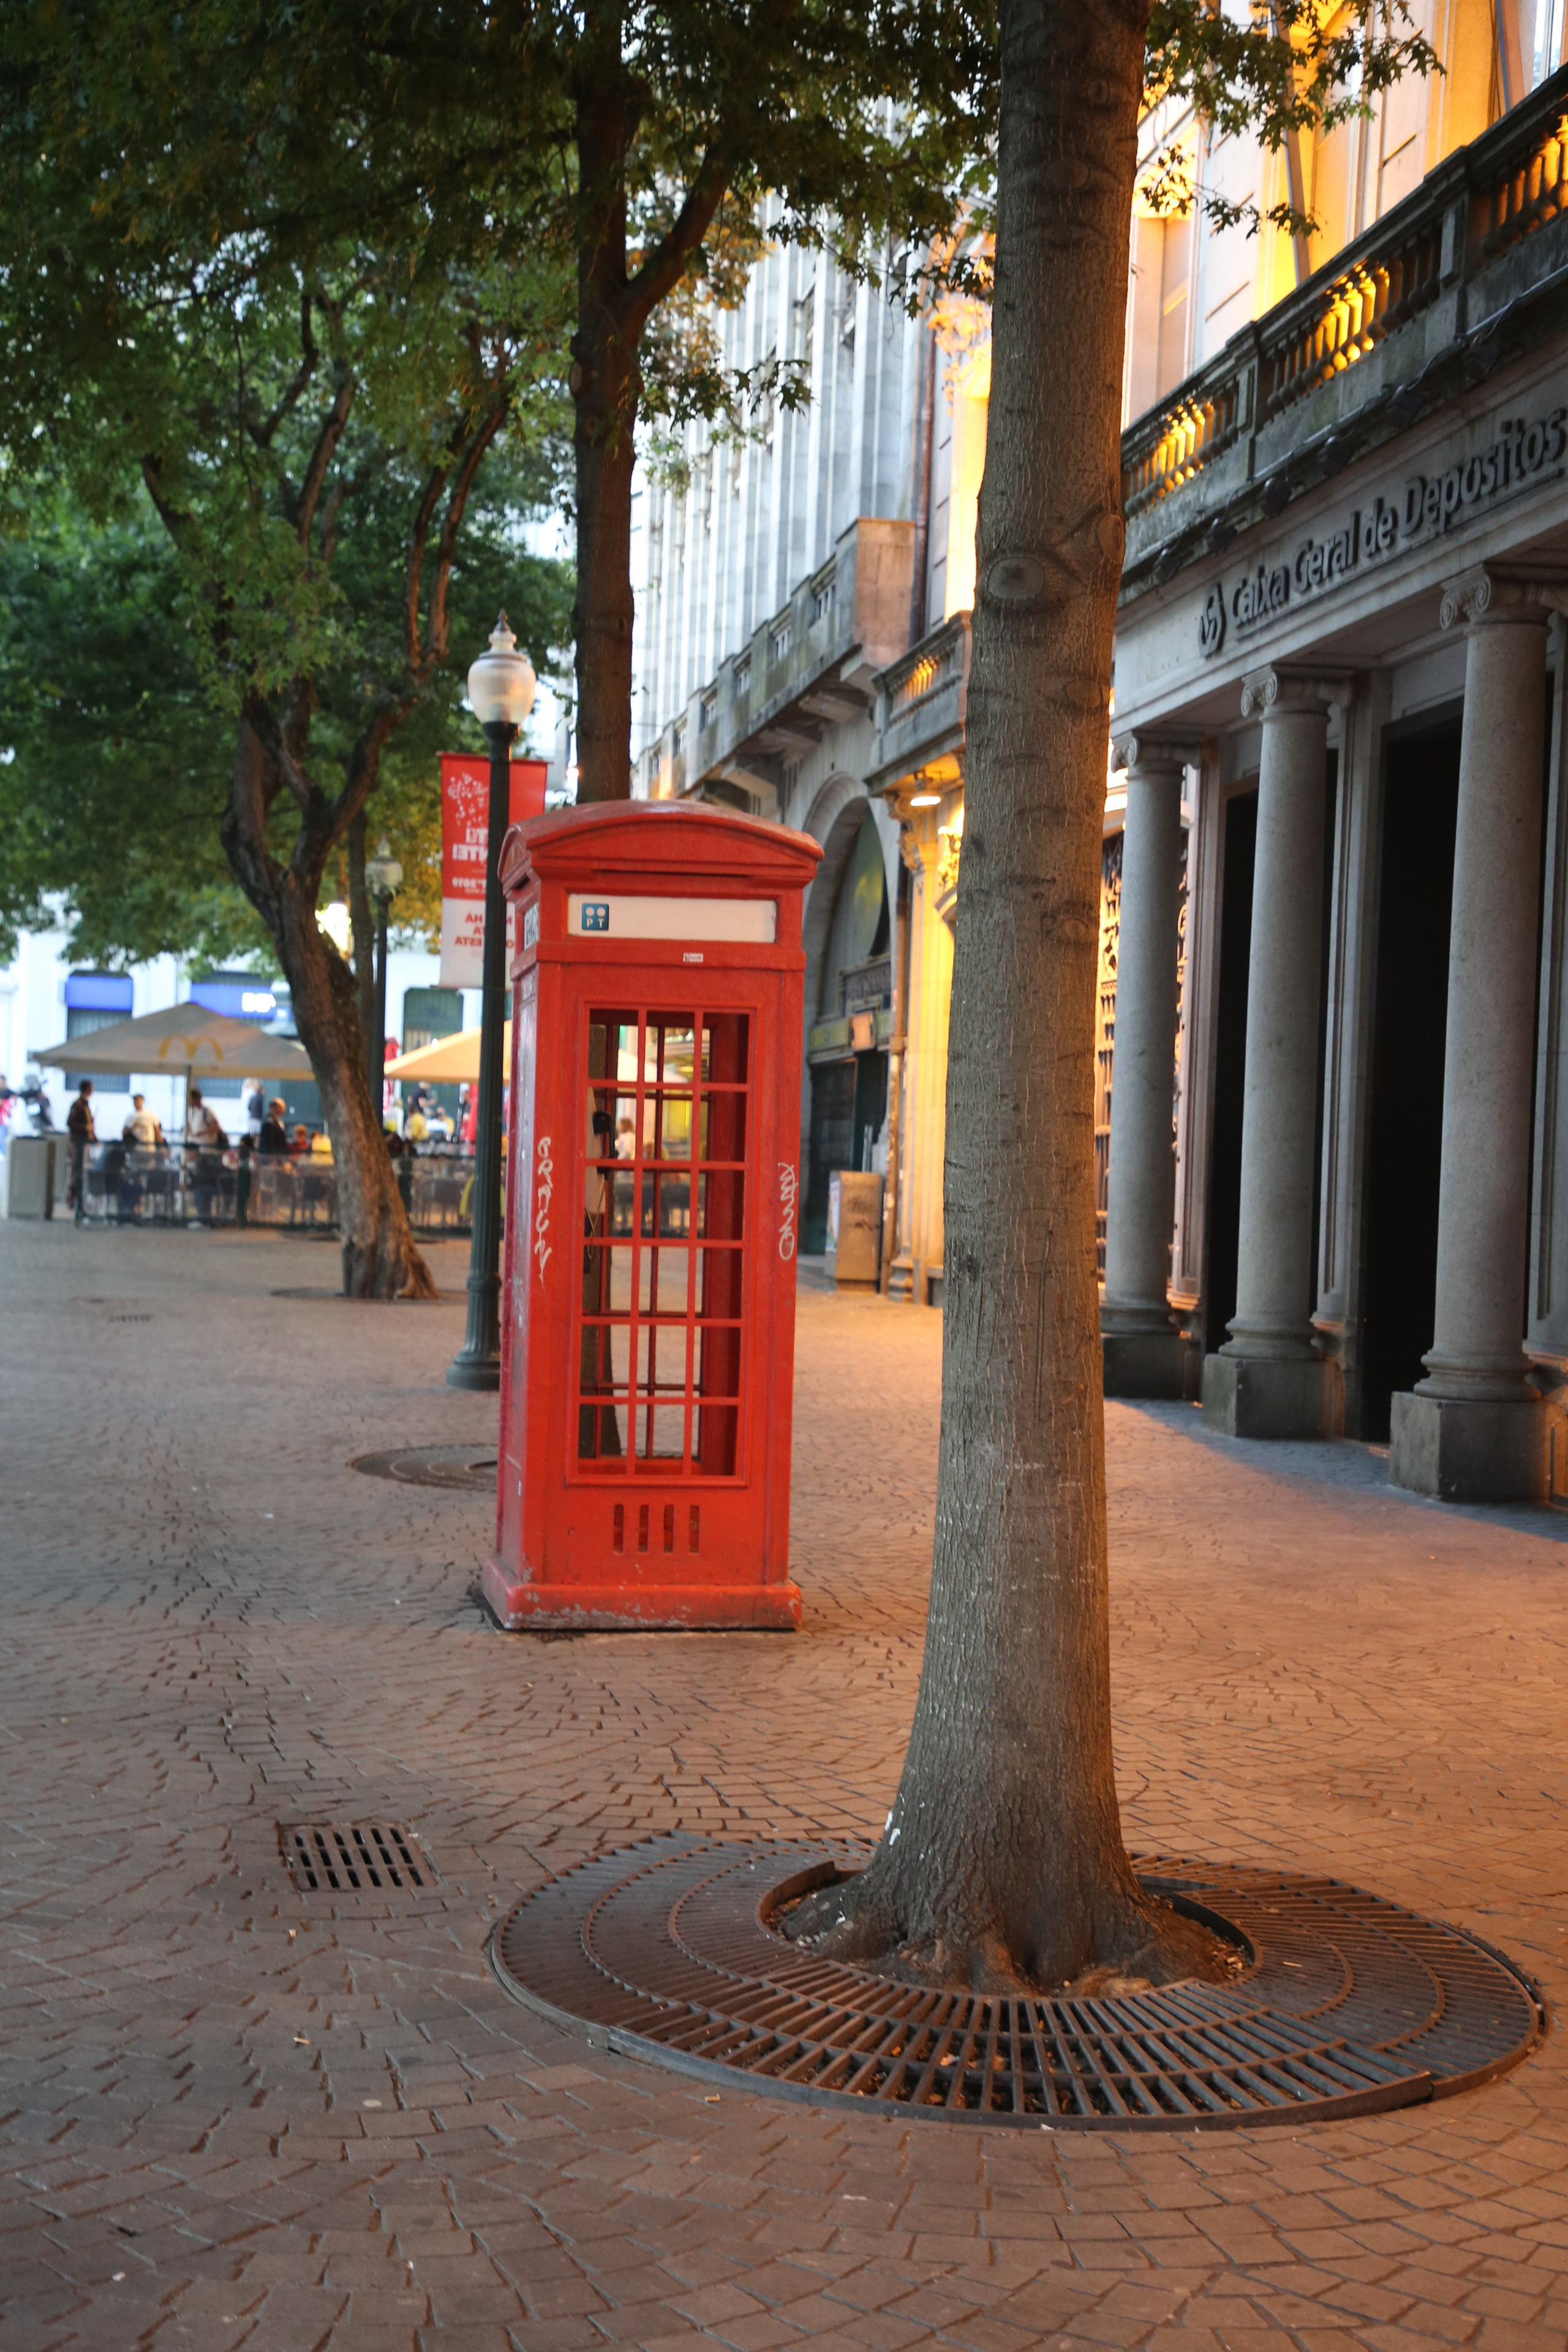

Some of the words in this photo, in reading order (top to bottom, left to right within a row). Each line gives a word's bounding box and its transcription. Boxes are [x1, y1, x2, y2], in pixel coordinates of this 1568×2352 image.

[1232, 565, 1290, 628] Caixa
[1292, 510, 1360, 594] Geral
[1361, 497, 1398, 557] de
[1400, 408, 1567, 538] Depositos
